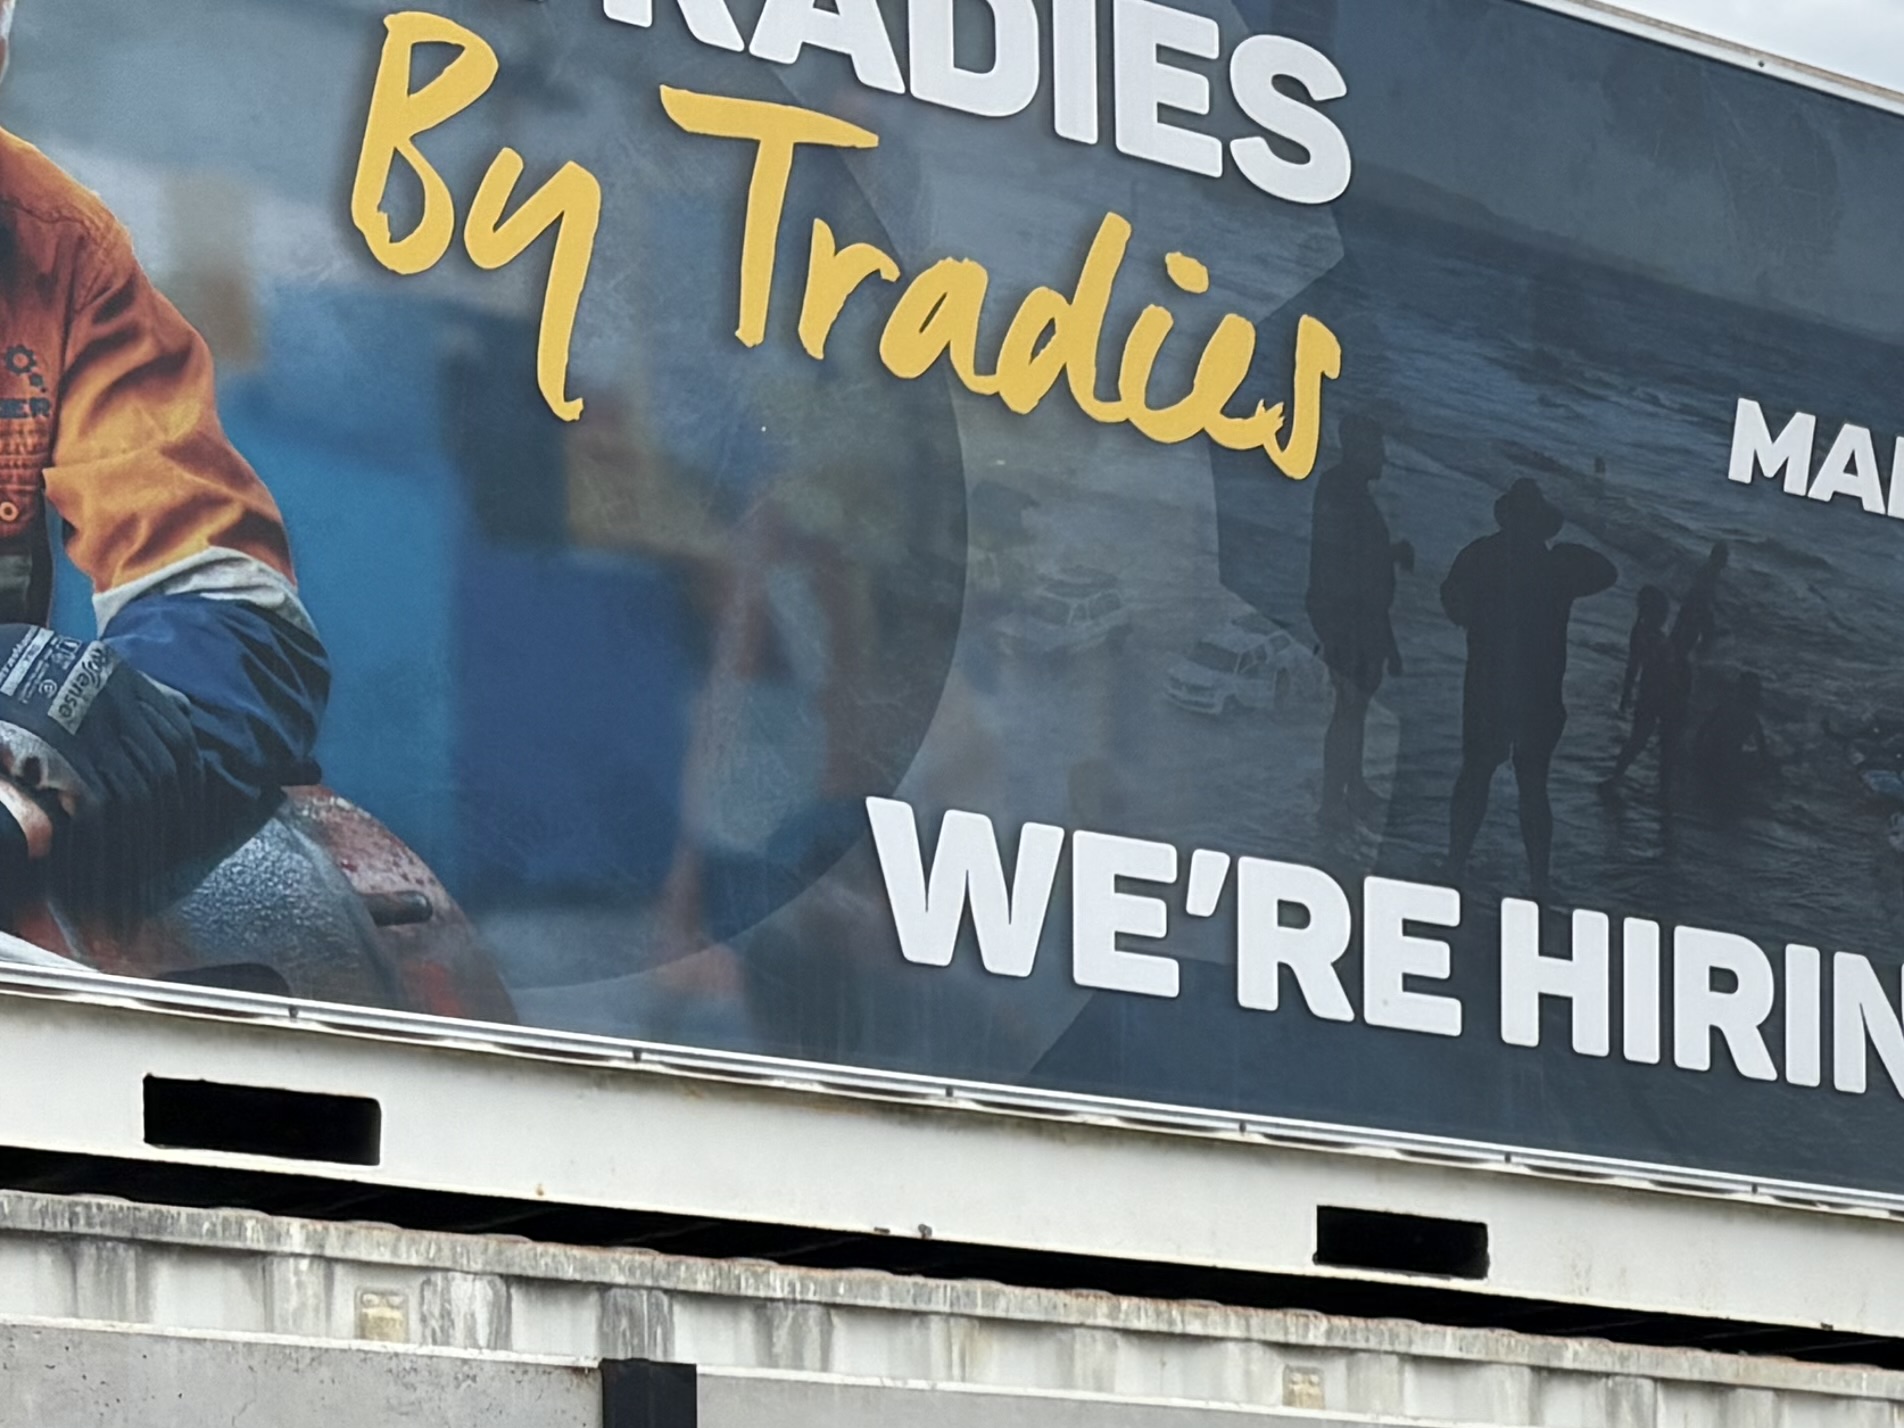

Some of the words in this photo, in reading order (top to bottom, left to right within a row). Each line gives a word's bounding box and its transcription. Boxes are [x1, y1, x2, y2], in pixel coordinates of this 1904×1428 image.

[352, 11, 600, 421] By
[662, 85, 1341, 478] Tradies
[865, 796, 1464, 1037] WE'RE
